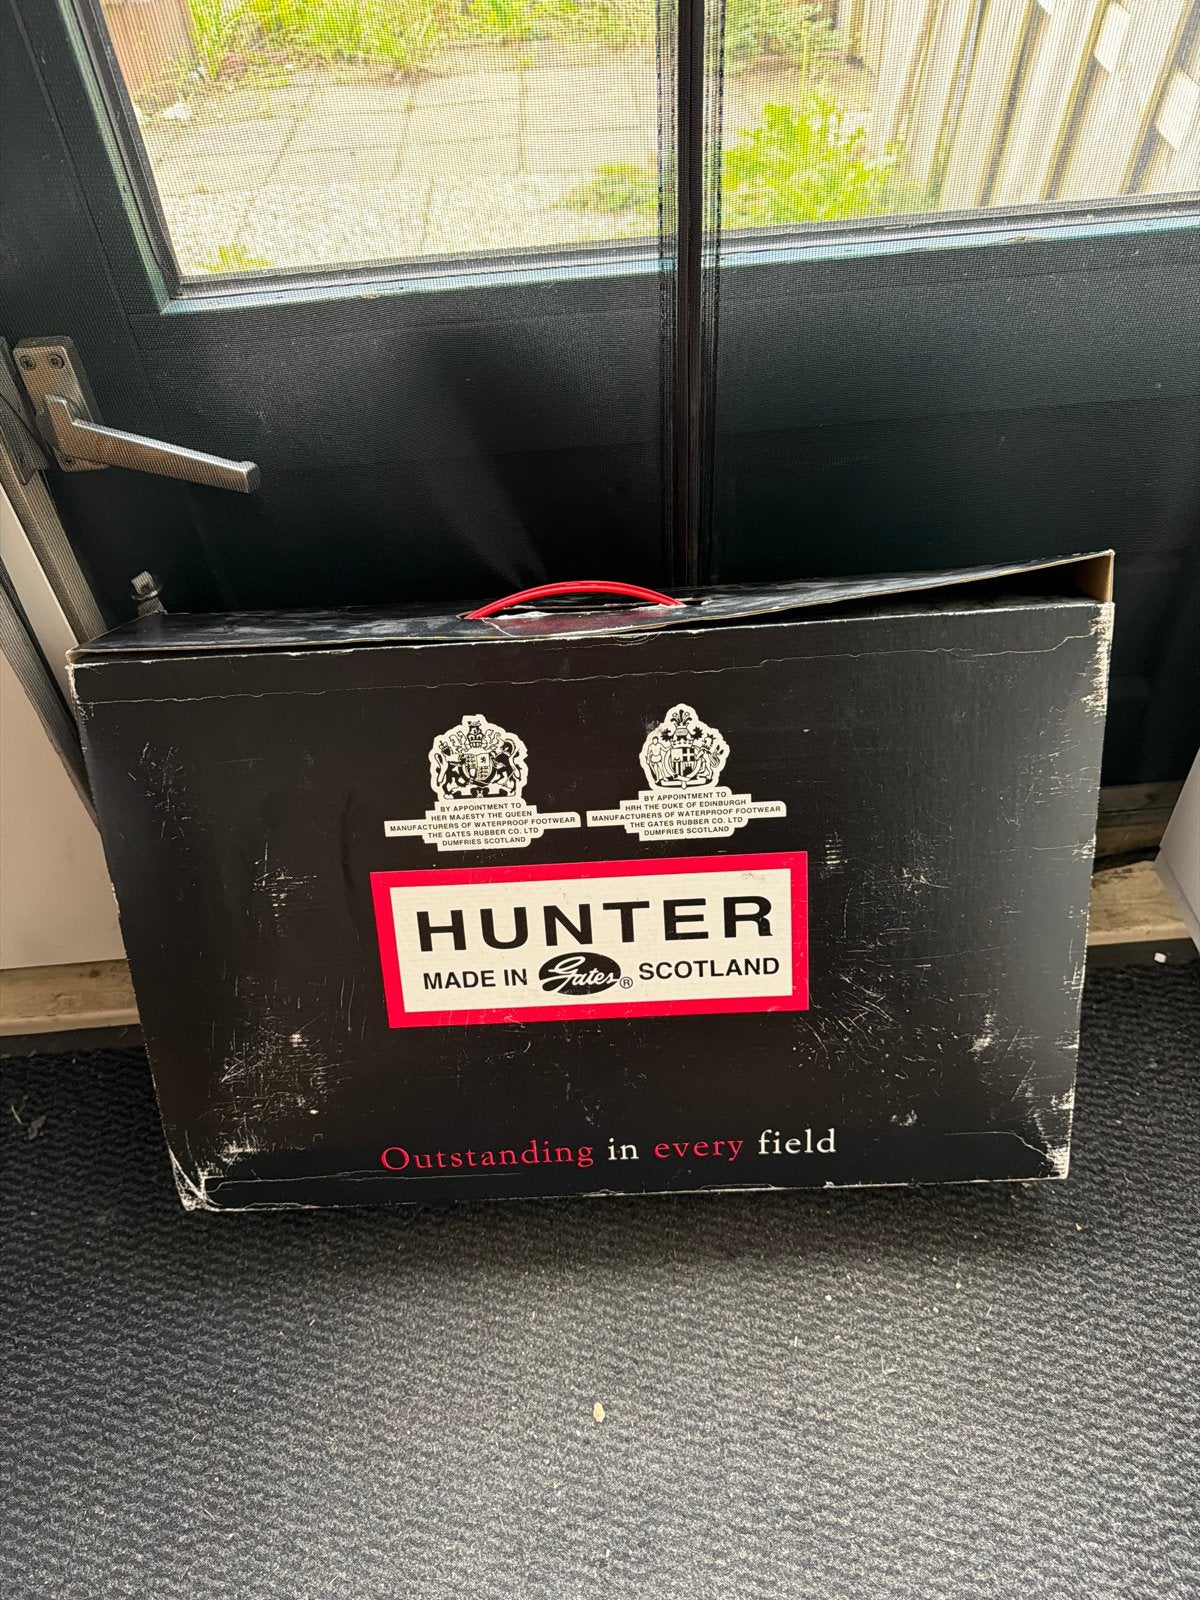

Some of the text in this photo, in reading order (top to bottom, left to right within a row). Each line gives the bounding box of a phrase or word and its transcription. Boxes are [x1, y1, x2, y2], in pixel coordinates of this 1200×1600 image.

[657, 792, 714, 801] APPOINTMENT
[700, 799, 746, 807] EDINBURGH
[592, 812, 662, 822] MANUFACTURERS
[678, 809, 733, 817] WATERPROOF
[735, 806, 781, 814] FOOTWEAR
[390, 822, 459, 831] MANUFACTURERS
[474, 819, 528, 828] WATERPROOF
[531, 817, 575, 825] FOOTWEAR
[677, 818, 709, 826] RUBBER
[445, 830, 471, 838] GATES
[644, 826, 729, 836] DUMFRIES SCOTLAND
[442, 836, 525, 846] DUMFRIES SCOTLAND
[416, 895, 773, 952] HUNTER
[423, 969, 497, 990] MADE
[504, 968, 528, 987] IN
[541, 956, 620, 993] Gates
[638, 957, 780, 981] SCOTLAND
[380, 1127, 836, 1171] Outstanding in every field
